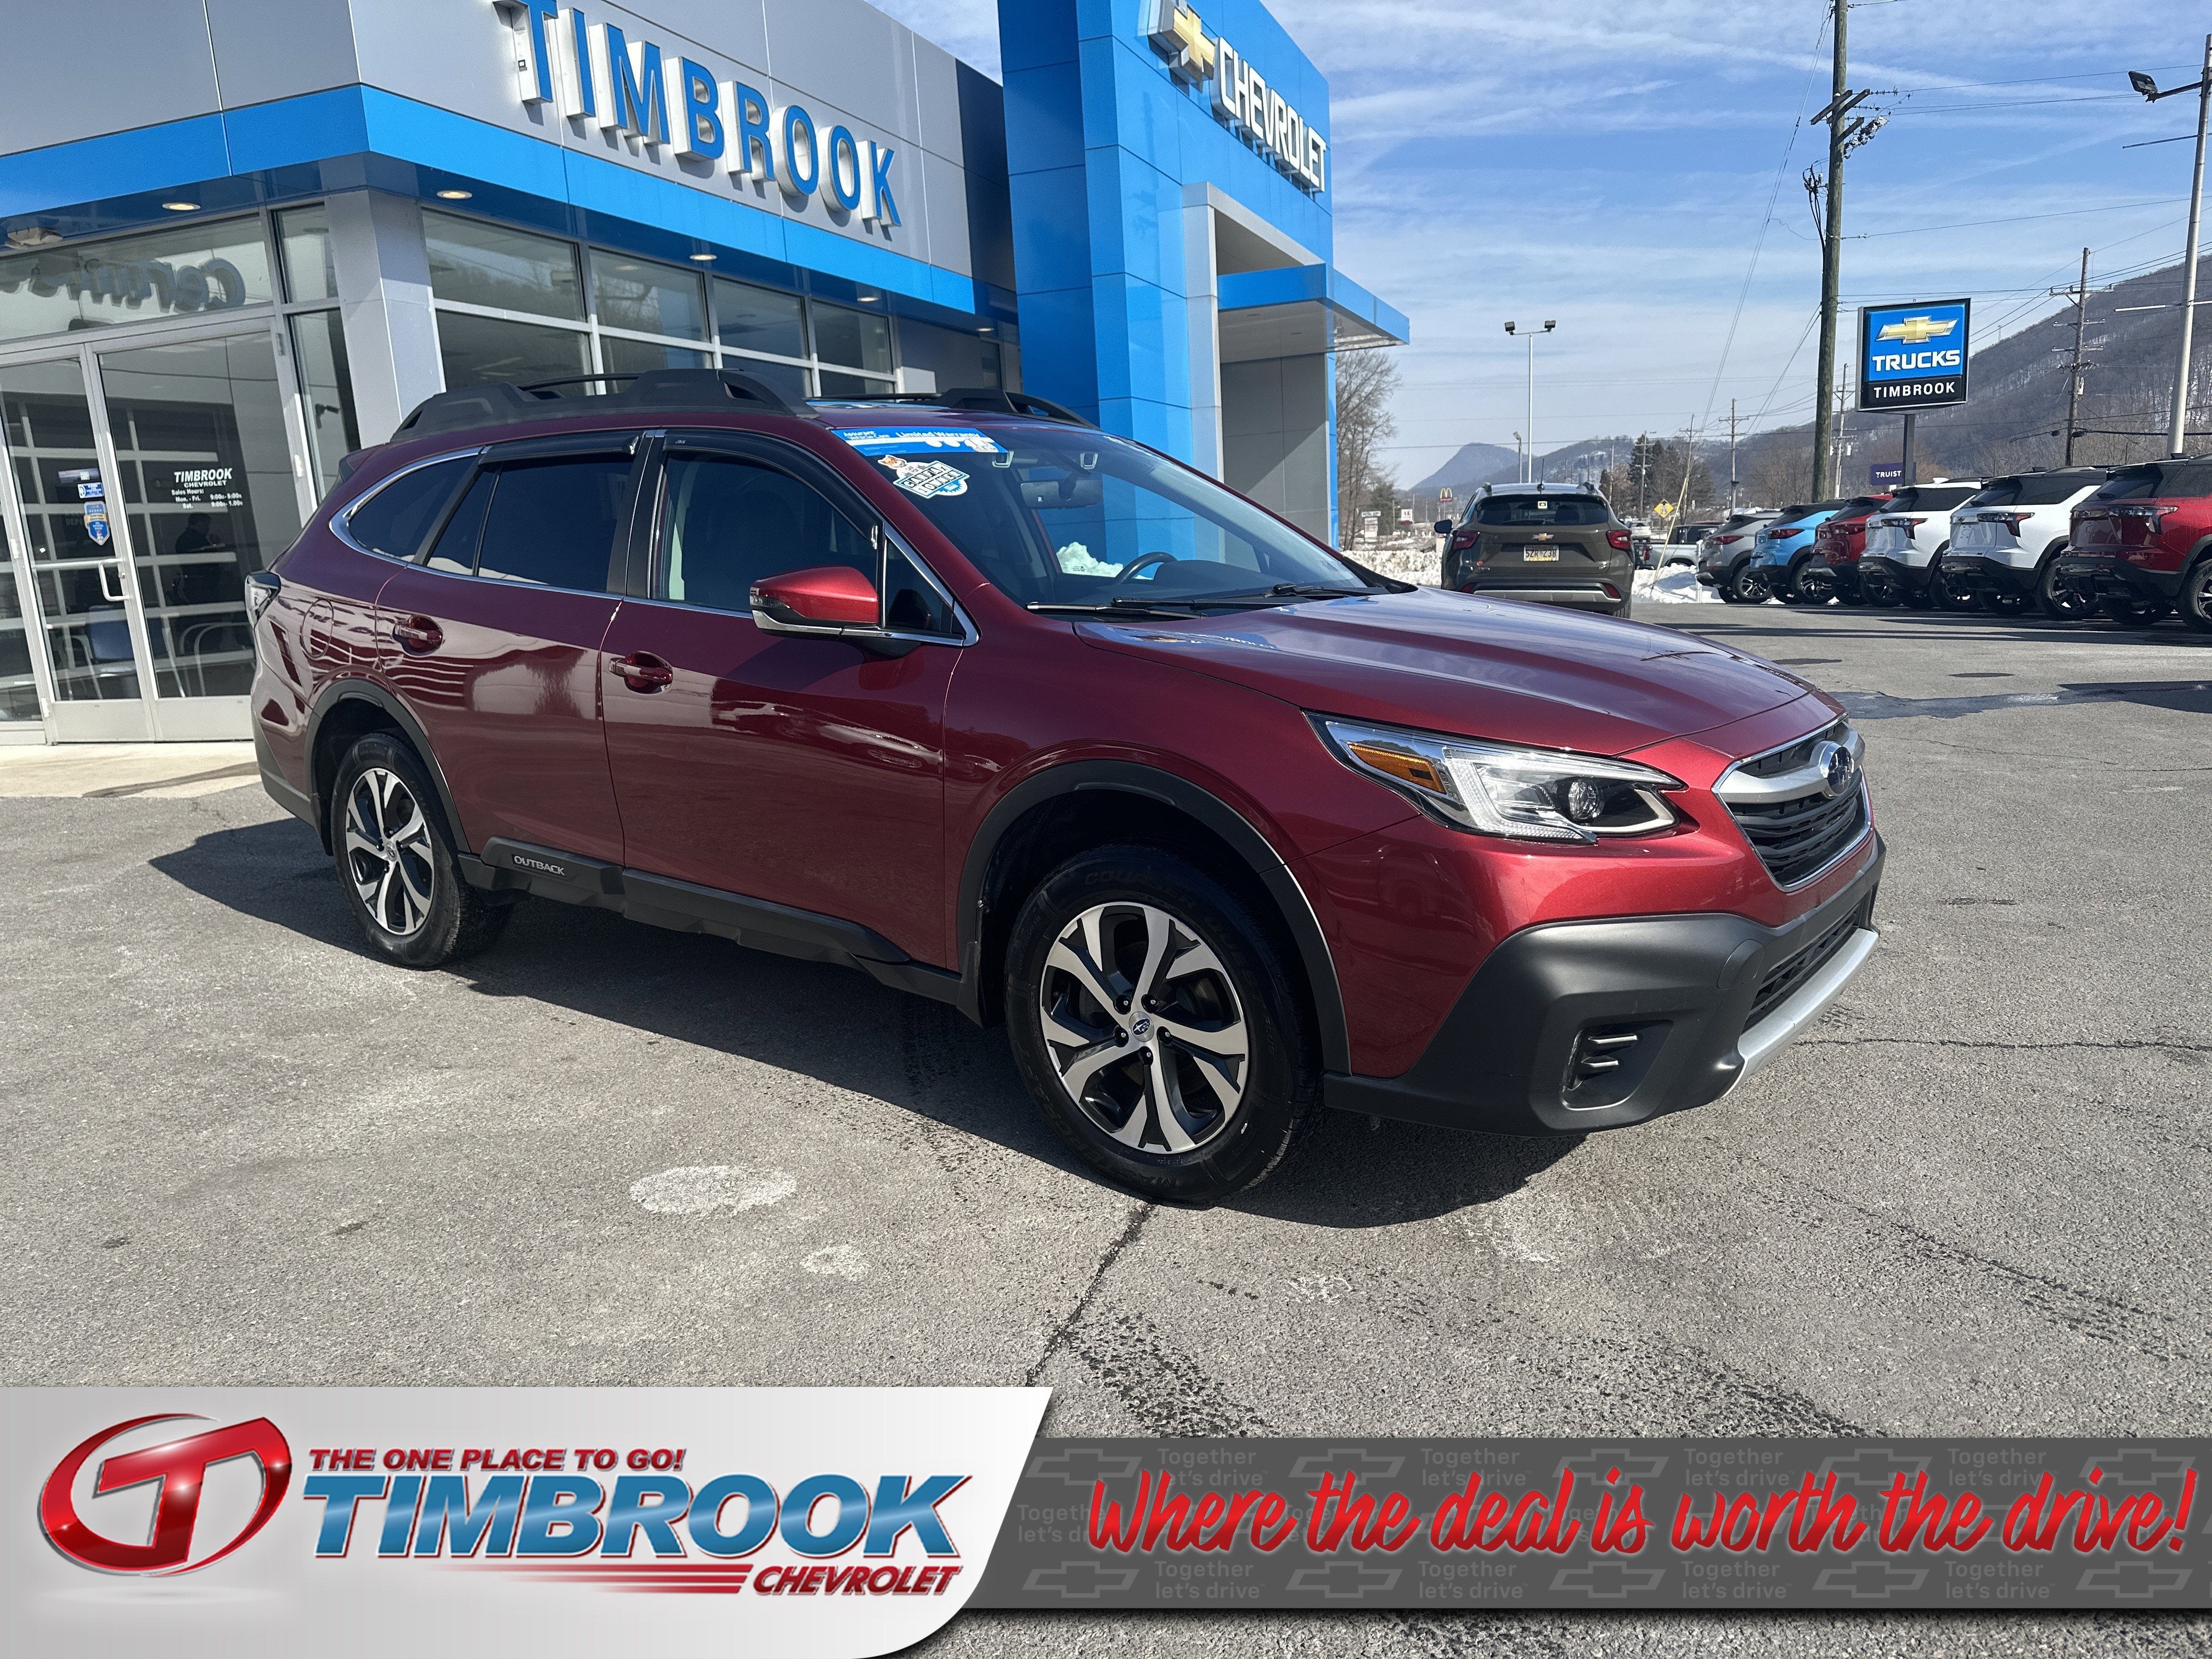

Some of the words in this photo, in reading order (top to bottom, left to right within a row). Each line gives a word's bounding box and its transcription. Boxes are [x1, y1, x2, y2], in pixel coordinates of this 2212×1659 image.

[494, 0, 901, 227] TIMBROOK
[1215, 36, 1327, 193] CHEVROLET
[1872, 349, 1960, 372] TRUCKS
[1874, 382, 1955, 398] TIMBROOK
[174, 467, 233, 483] TIMBROOK
[184, 479, 227, 488] CHEVROLET
[901, 466, 949, 488] CARFAX
[514, 856, 566, 876] OUTBACK
